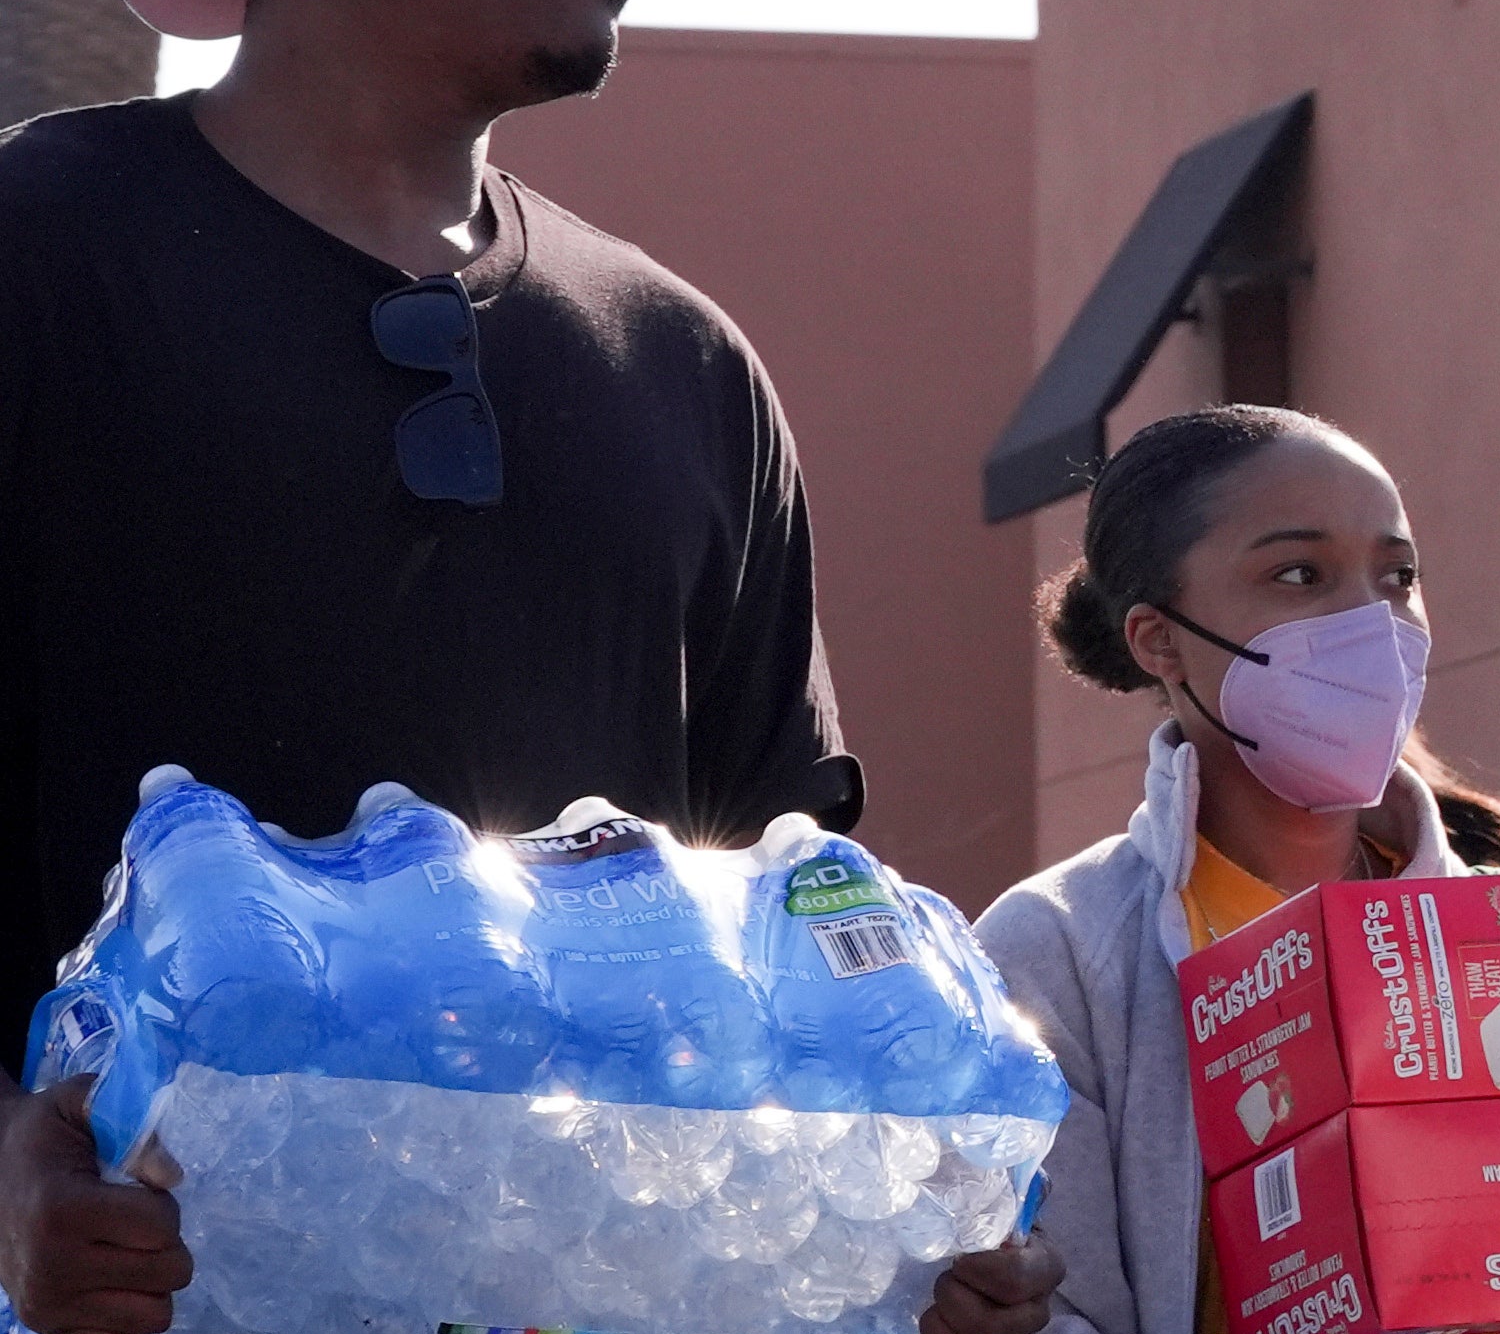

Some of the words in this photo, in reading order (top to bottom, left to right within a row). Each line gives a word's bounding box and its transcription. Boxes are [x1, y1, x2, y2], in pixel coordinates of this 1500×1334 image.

[790, 864, 850, 889] 40
[794, 886, 888, 910] BOTTLE
[608, 906, 672, 927] added
[1410, 943, 1422, 960] JAM
[1192, 929, 1312, 1043] CrustOffs
[1363, 899, 1424, 1079] CrustOffs
[1413, 962, 1430, 1009] STRAWBERRY
[1464, 962, 1486, 1000] THAW
